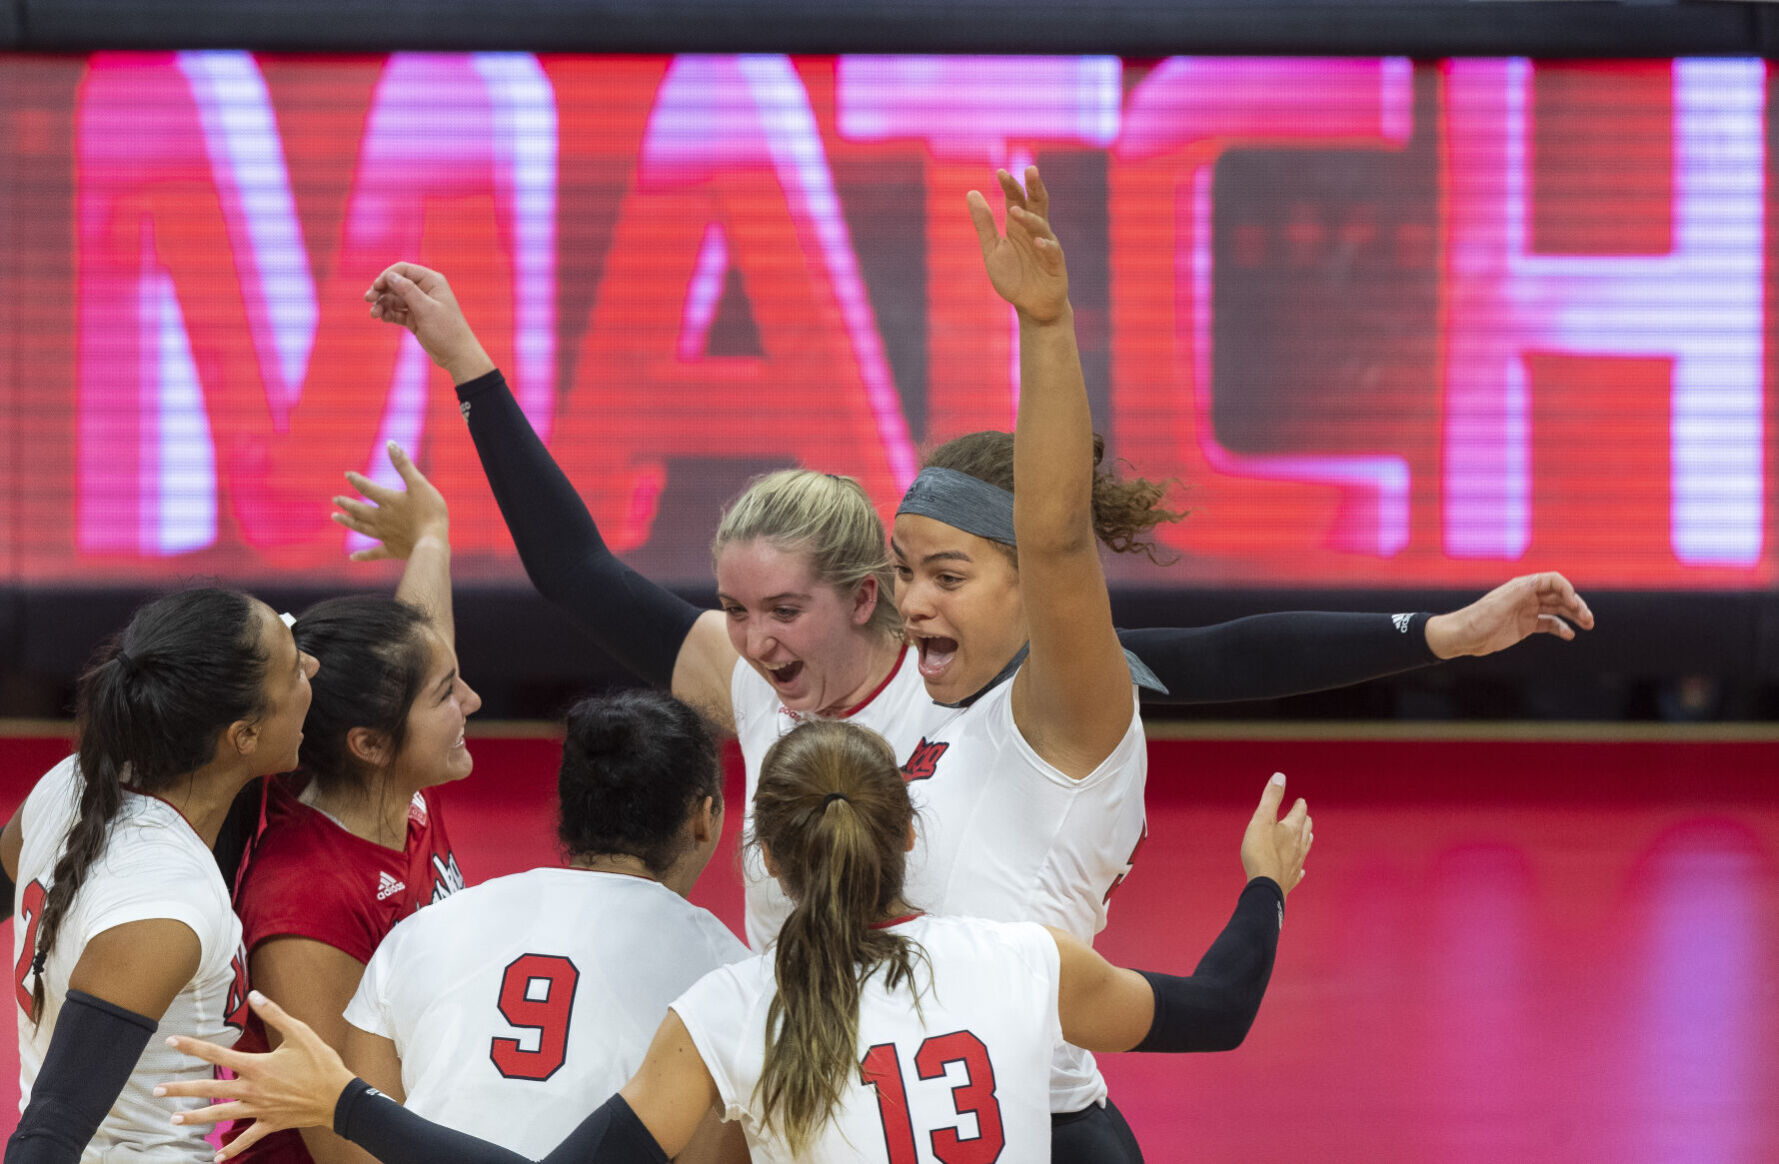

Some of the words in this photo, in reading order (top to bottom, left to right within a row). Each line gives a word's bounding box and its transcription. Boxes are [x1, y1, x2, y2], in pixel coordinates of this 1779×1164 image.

[76, 50, 1766, 566] MATCH
[377, 881, 406, 901] adidas
[489, 953, 580, 1082] 9
[859, 1029, 1006, 1164] 13
